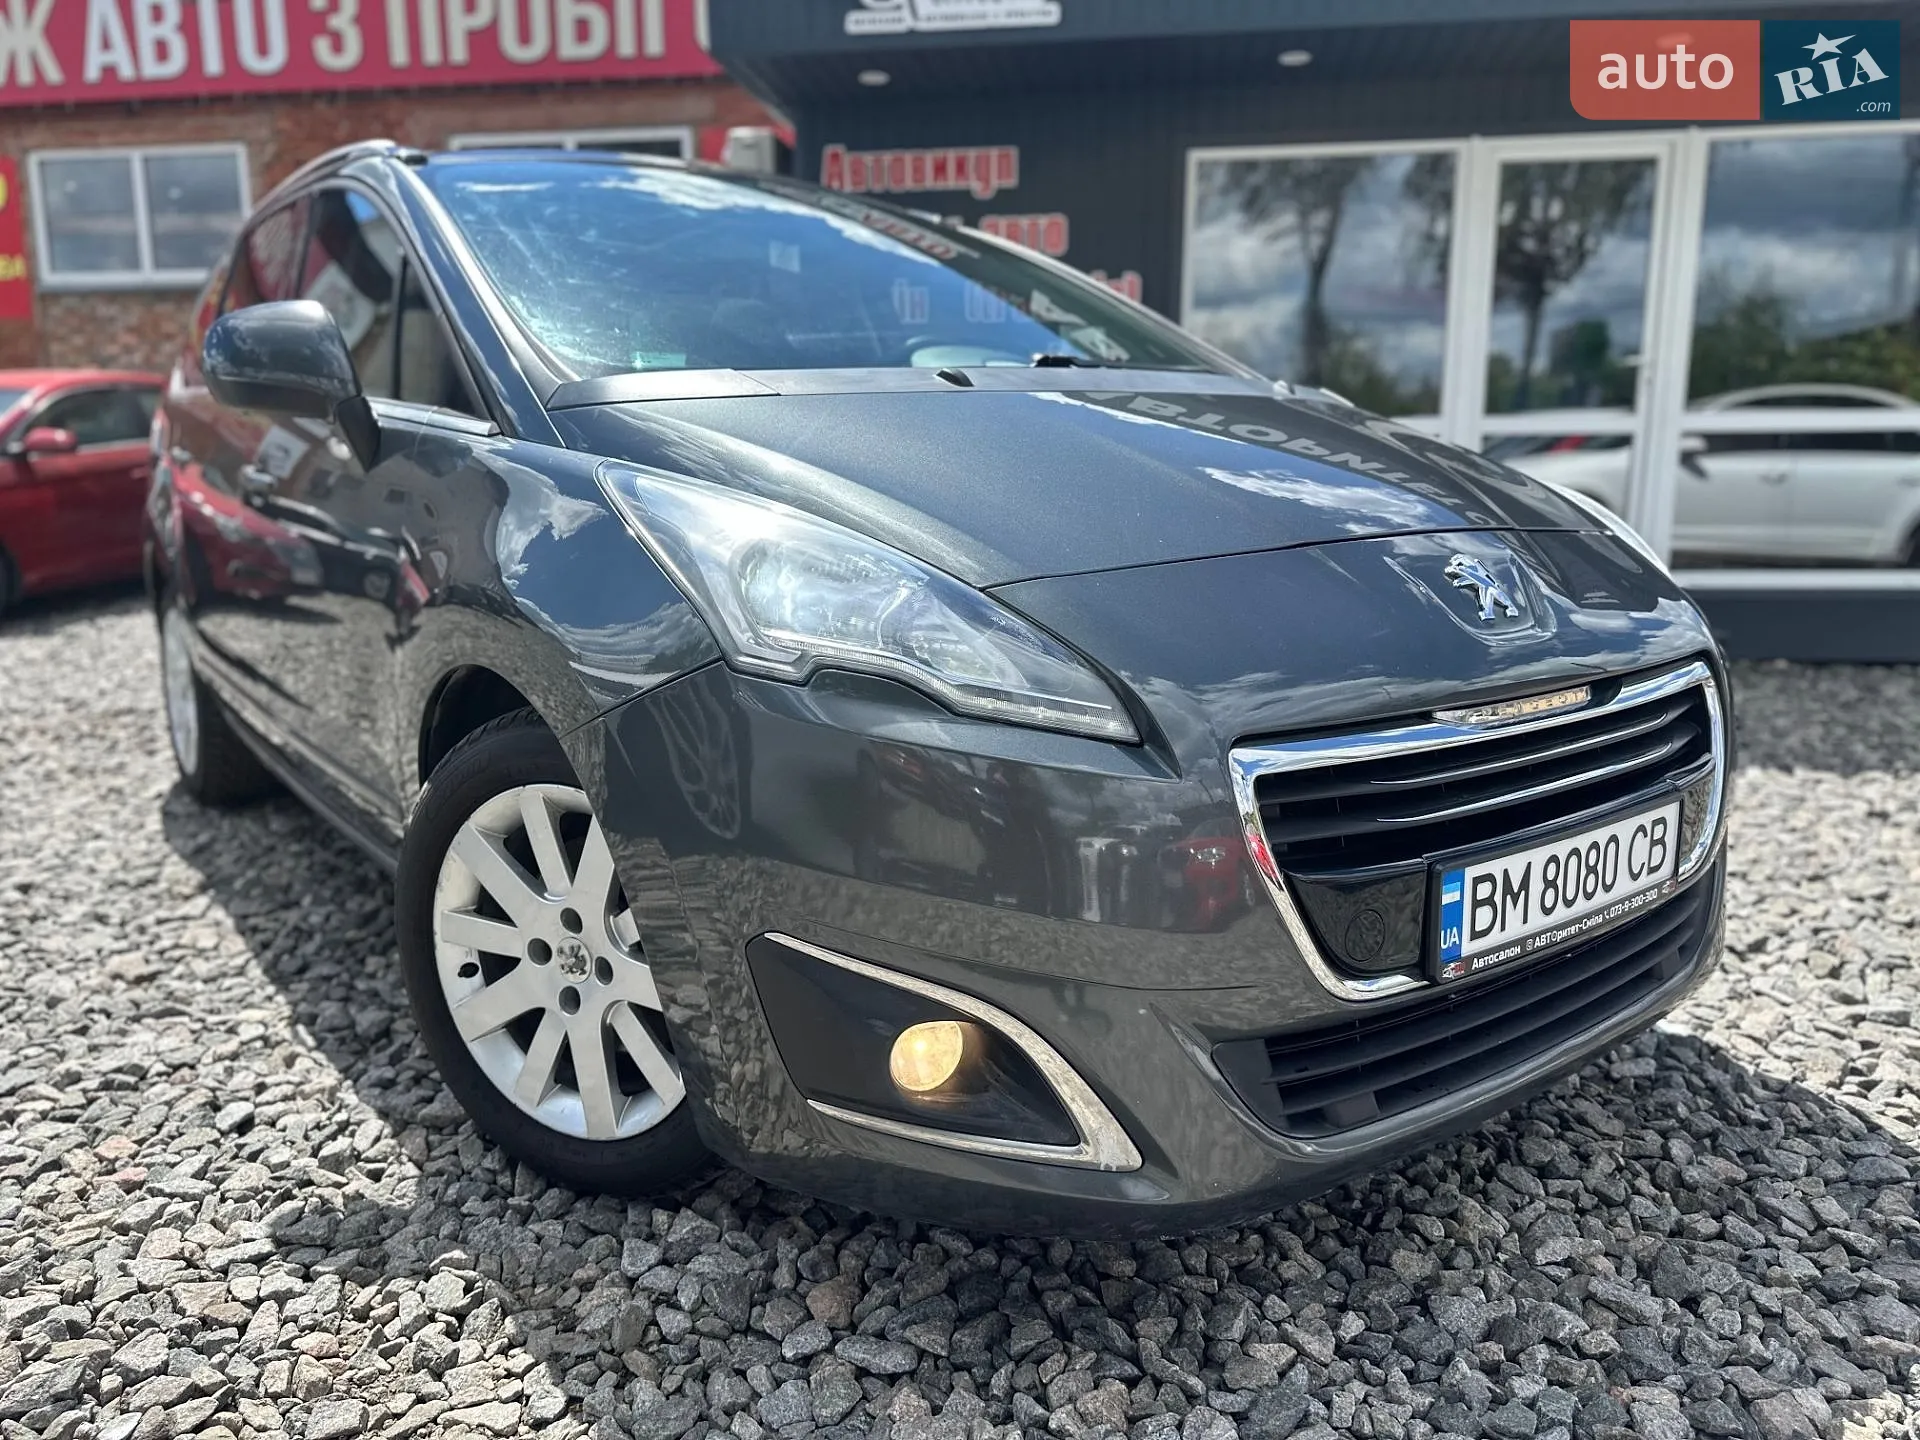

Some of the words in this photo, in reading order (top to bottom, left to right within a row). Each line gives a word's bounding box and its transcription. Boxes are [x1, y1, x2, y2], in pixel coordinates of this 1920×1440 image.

[82, 0, 289, 84] АВТО
[1469, 860, 1532, 942] BM
[1539, 833, 1620, 917] 8080
[1627, 816, 1668, 882] CB
[1440, 927, 1460, 949] UA
[1471, 945, 1521, 970] Автосалон
